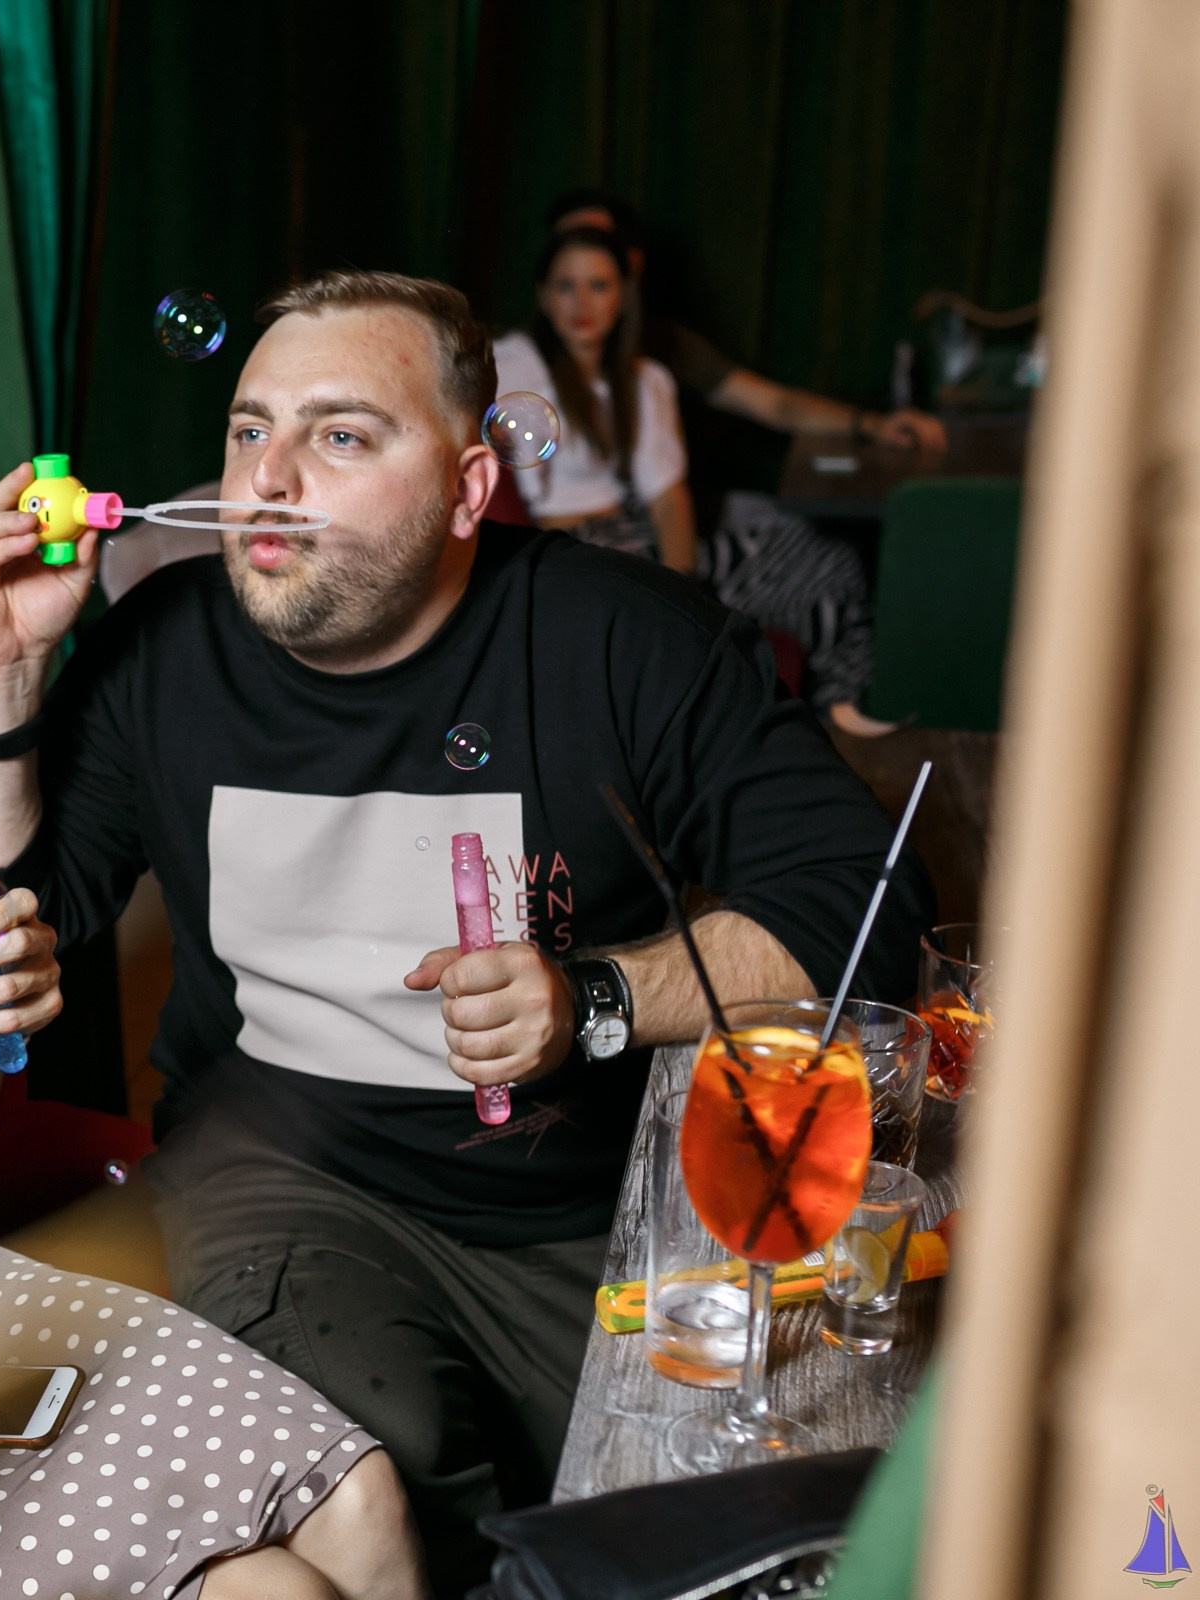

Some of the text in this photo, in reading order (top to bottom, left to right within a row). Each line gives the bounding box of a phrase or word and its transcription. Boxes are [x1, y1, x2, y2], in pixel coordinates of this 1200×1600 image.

[485, 851, 571, 885] AWA
[489, 885, 573, 922] REN
[493, 922, 573, 952] SS
